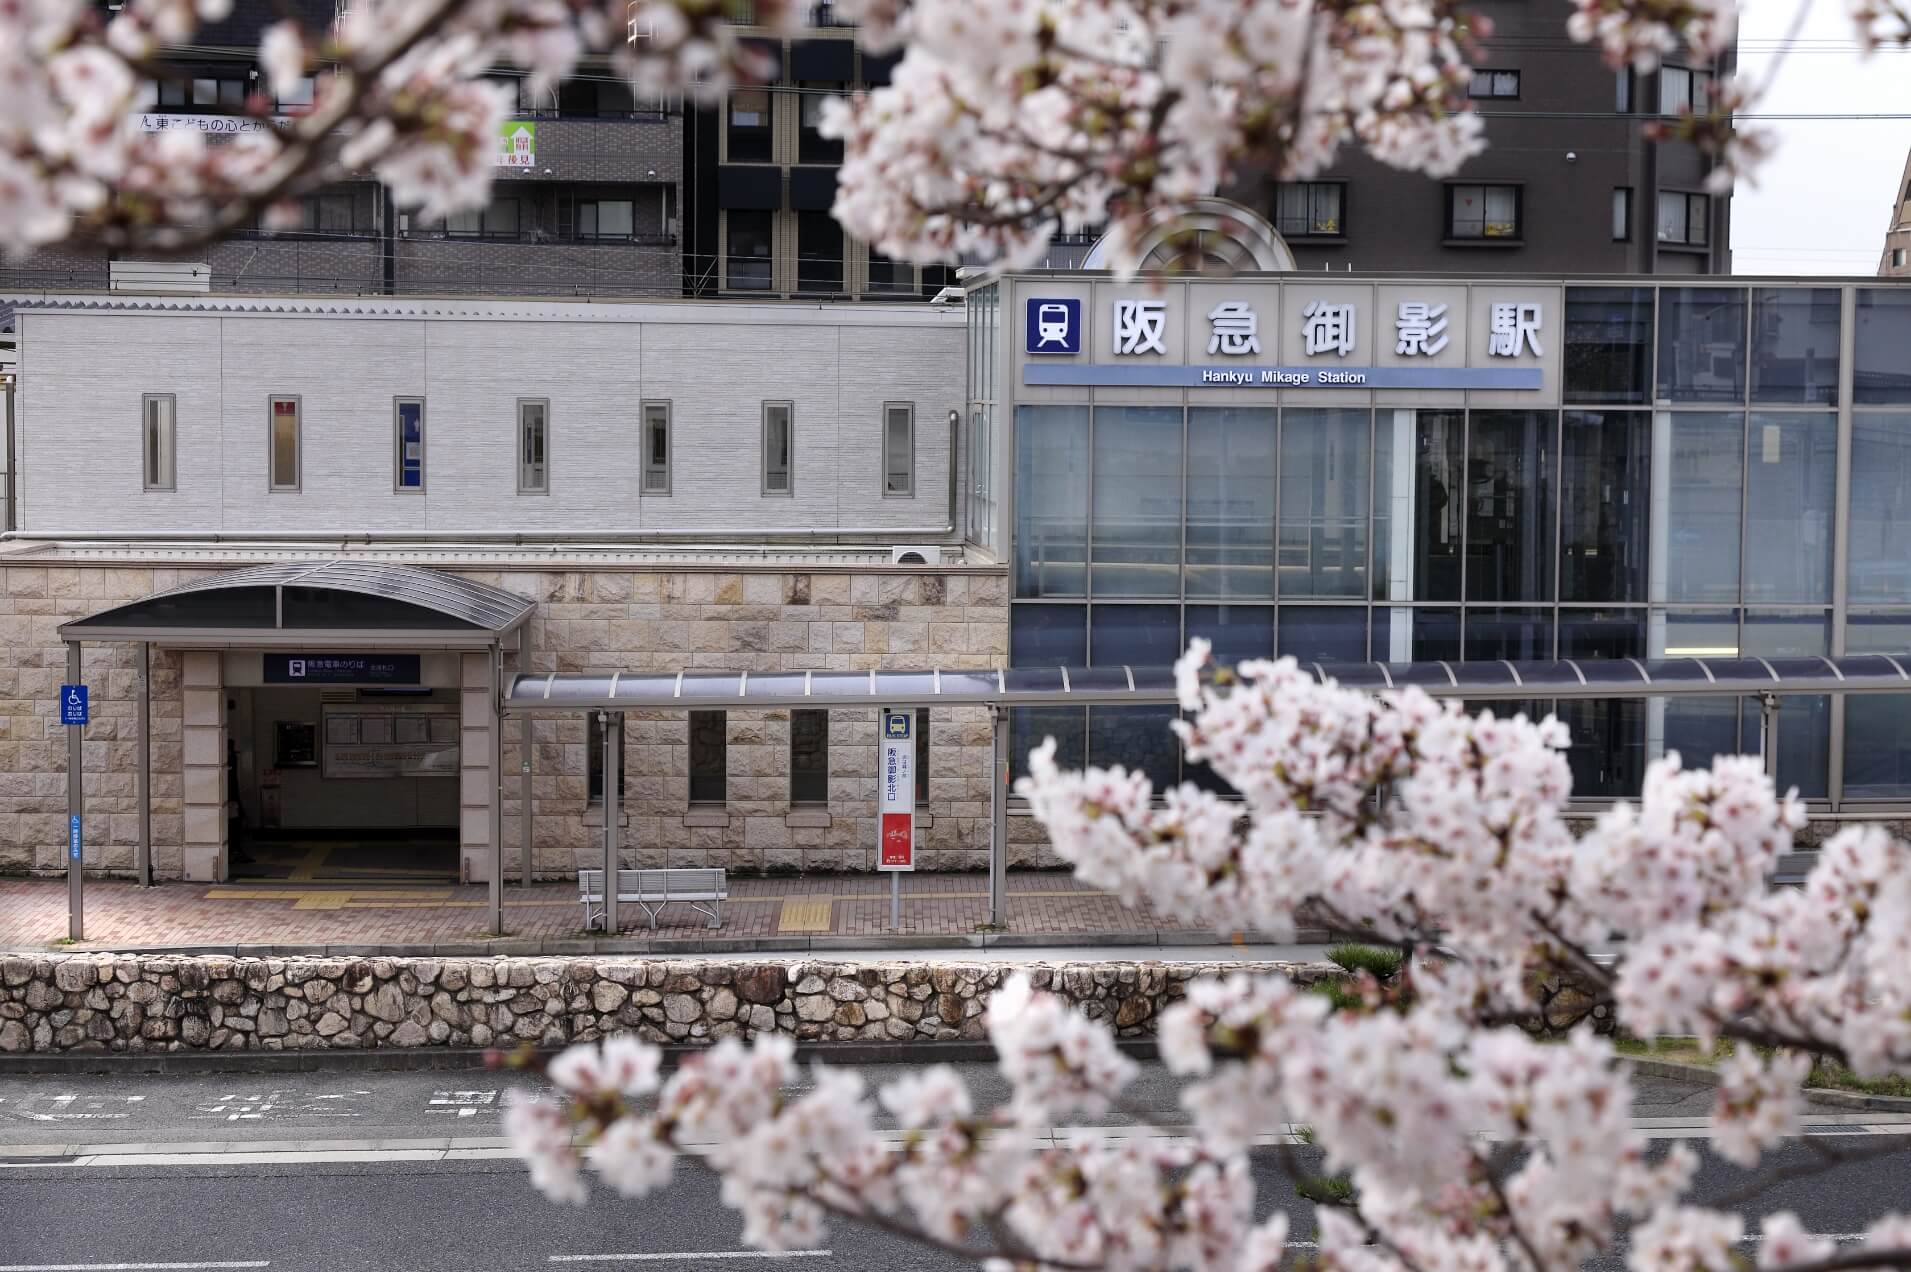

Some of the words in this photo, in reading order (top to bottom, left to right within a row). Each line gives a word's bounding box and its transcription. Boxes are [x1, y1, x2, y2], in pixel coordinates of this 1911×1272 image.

[1112, 299, 1544, 357] 阪急御影駅
[1202, 370, 1253, 385] Hankyu
[1261, 371, 1310, 386] Mikage
[1318, 371, 1366, 384] Station
[887, 747, 897, 801] 阪急御影北口
